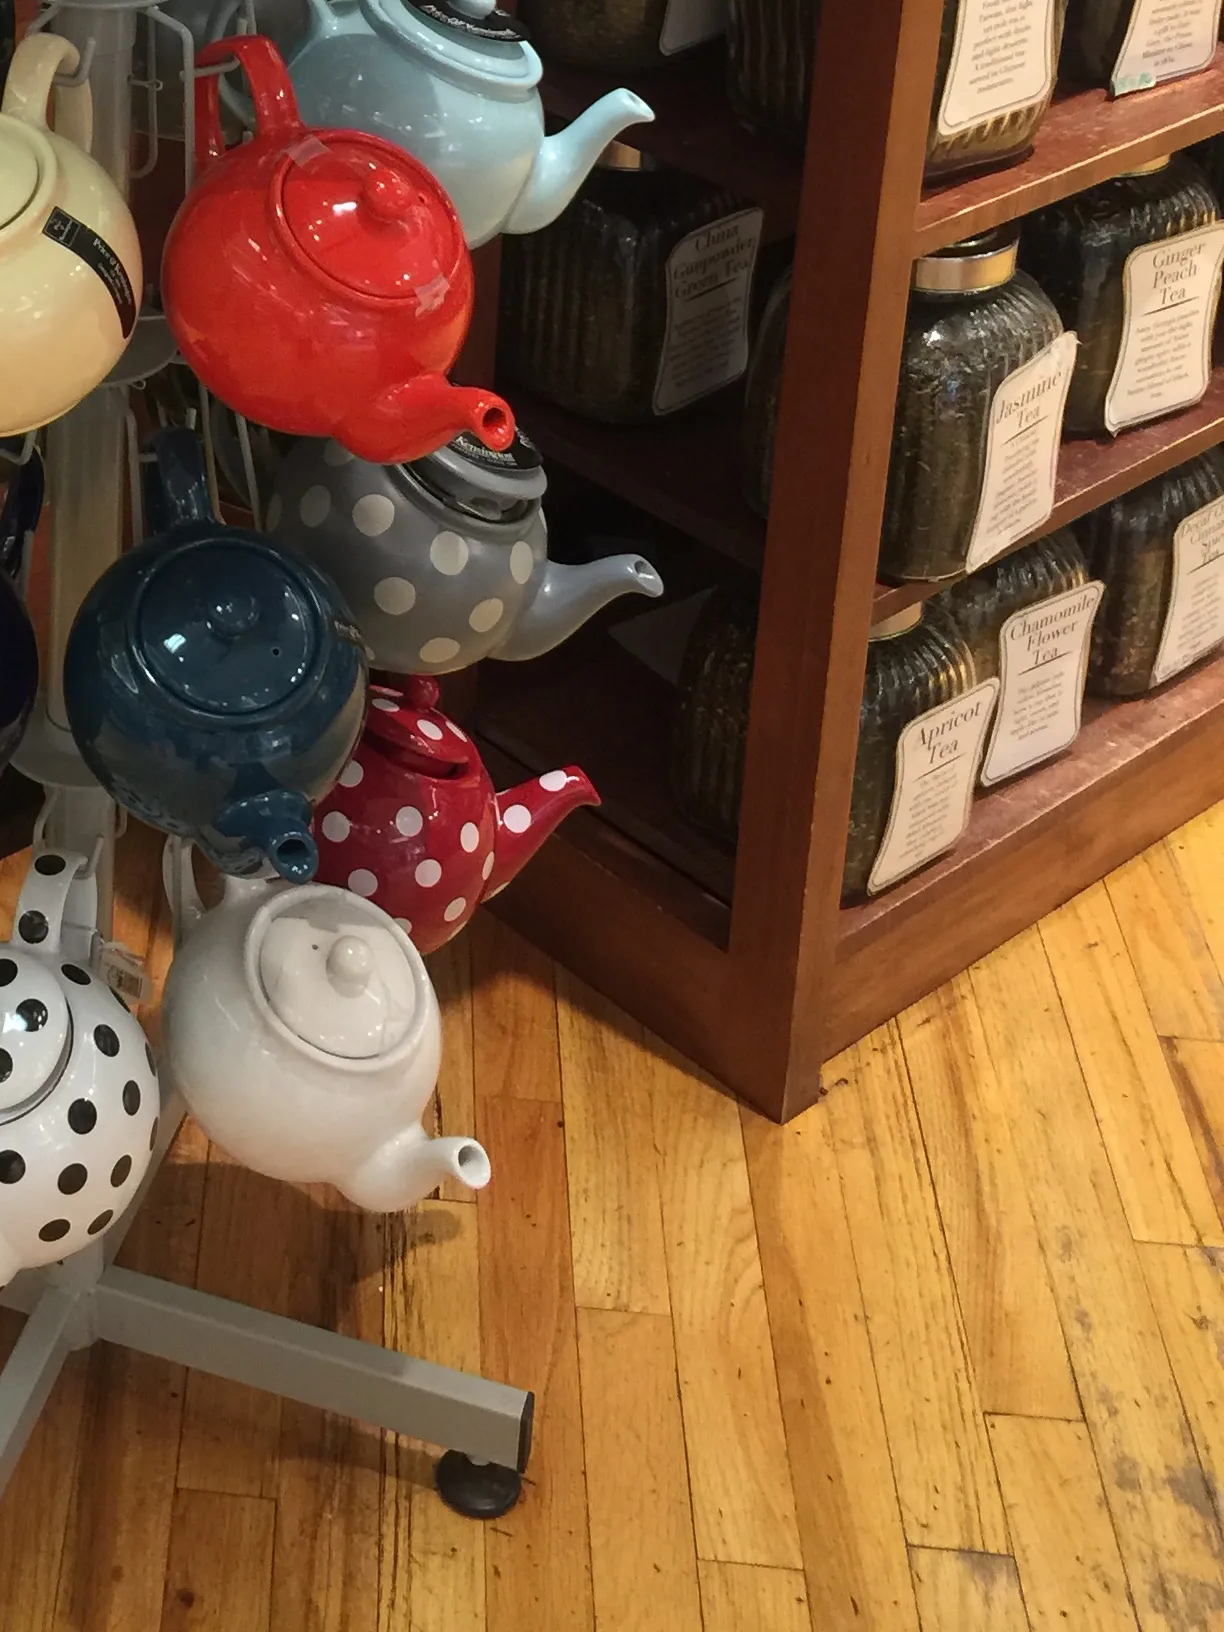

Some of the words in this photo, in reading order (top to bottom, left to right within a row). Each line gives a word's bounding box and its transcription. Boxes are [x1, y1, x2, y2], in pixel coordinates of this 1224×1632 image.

[694, 224, 739, 252] China
[673, 236, 756, 281] Gunpowder
[1152, 242, 1204, 269] Ginger
[674, 271, 719, 298] Green
[1153, 259, 1198, 288] Peach
[1160, 286, 1187, 305] Tea
[996, 371, 1062, 424] Jasmine
[1017, 405, 1040, 429] Tea
[1010, 594, 1096, 641] Chamomile
[1027, 620, 1079, 652] Flower
[1032, 647, 1059, 666] Tea
[914, 701, 981, 752] Apricot
[929, 739, 959, 765] Tea
